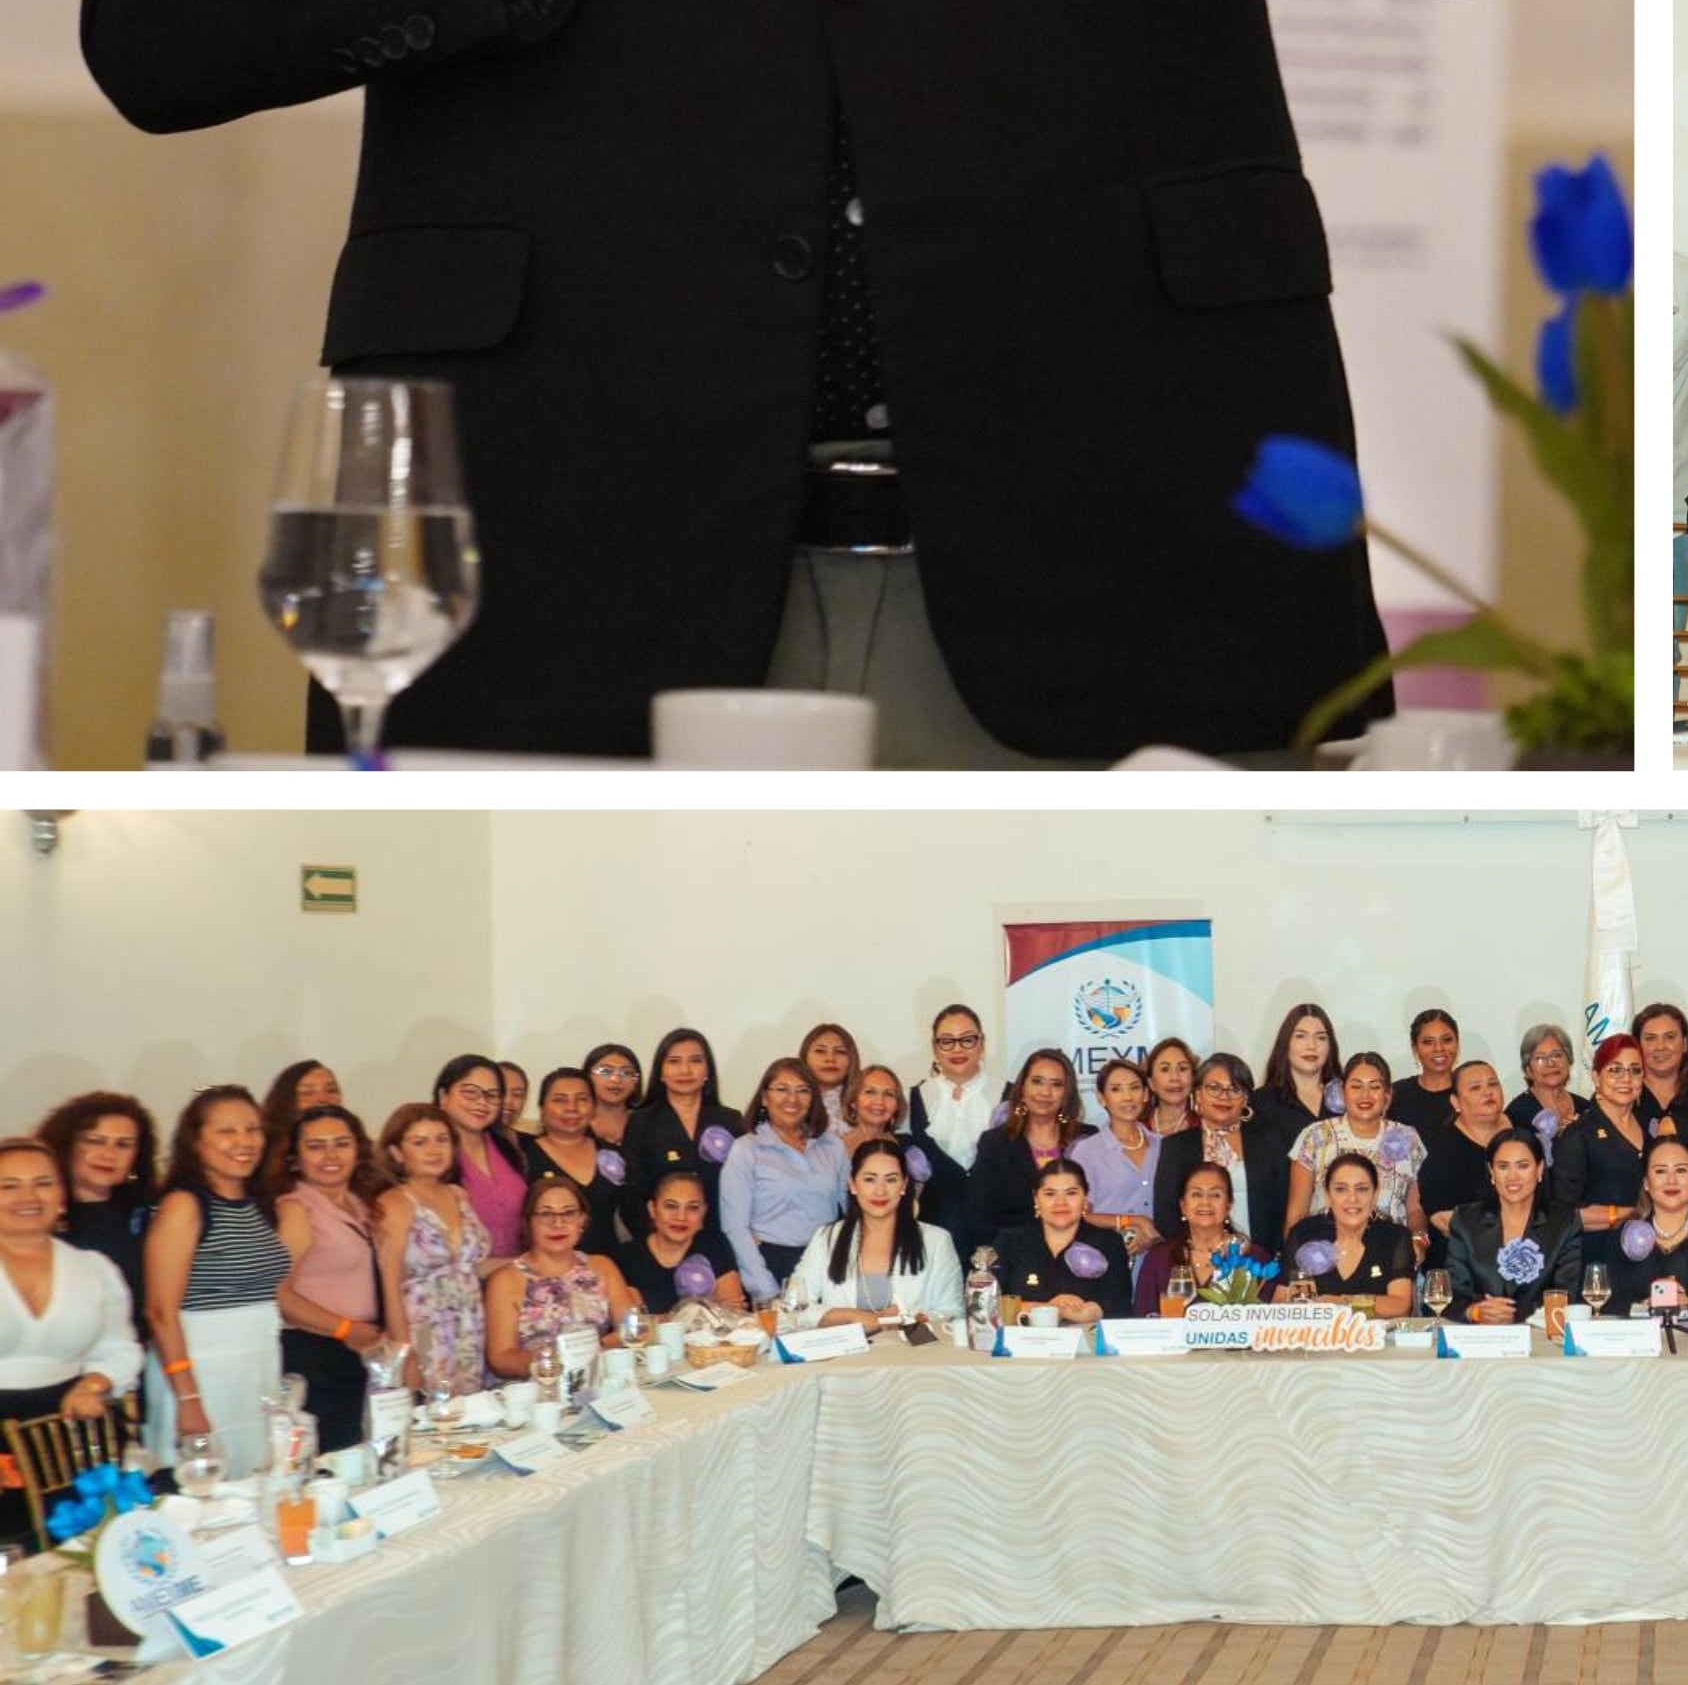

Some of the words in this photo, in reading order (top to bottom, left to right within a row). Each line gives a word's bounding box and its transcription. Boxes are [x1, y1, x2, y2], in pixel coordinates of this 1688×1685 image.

[1188, 1309, 1241, 1322] SOLAS
[1246, 1307, 1334, 1321] INVISIBLES
[1186, 1332, 1248, 1345] UNIDAS
[1255, 1312, 1377, 1350] invencibles
